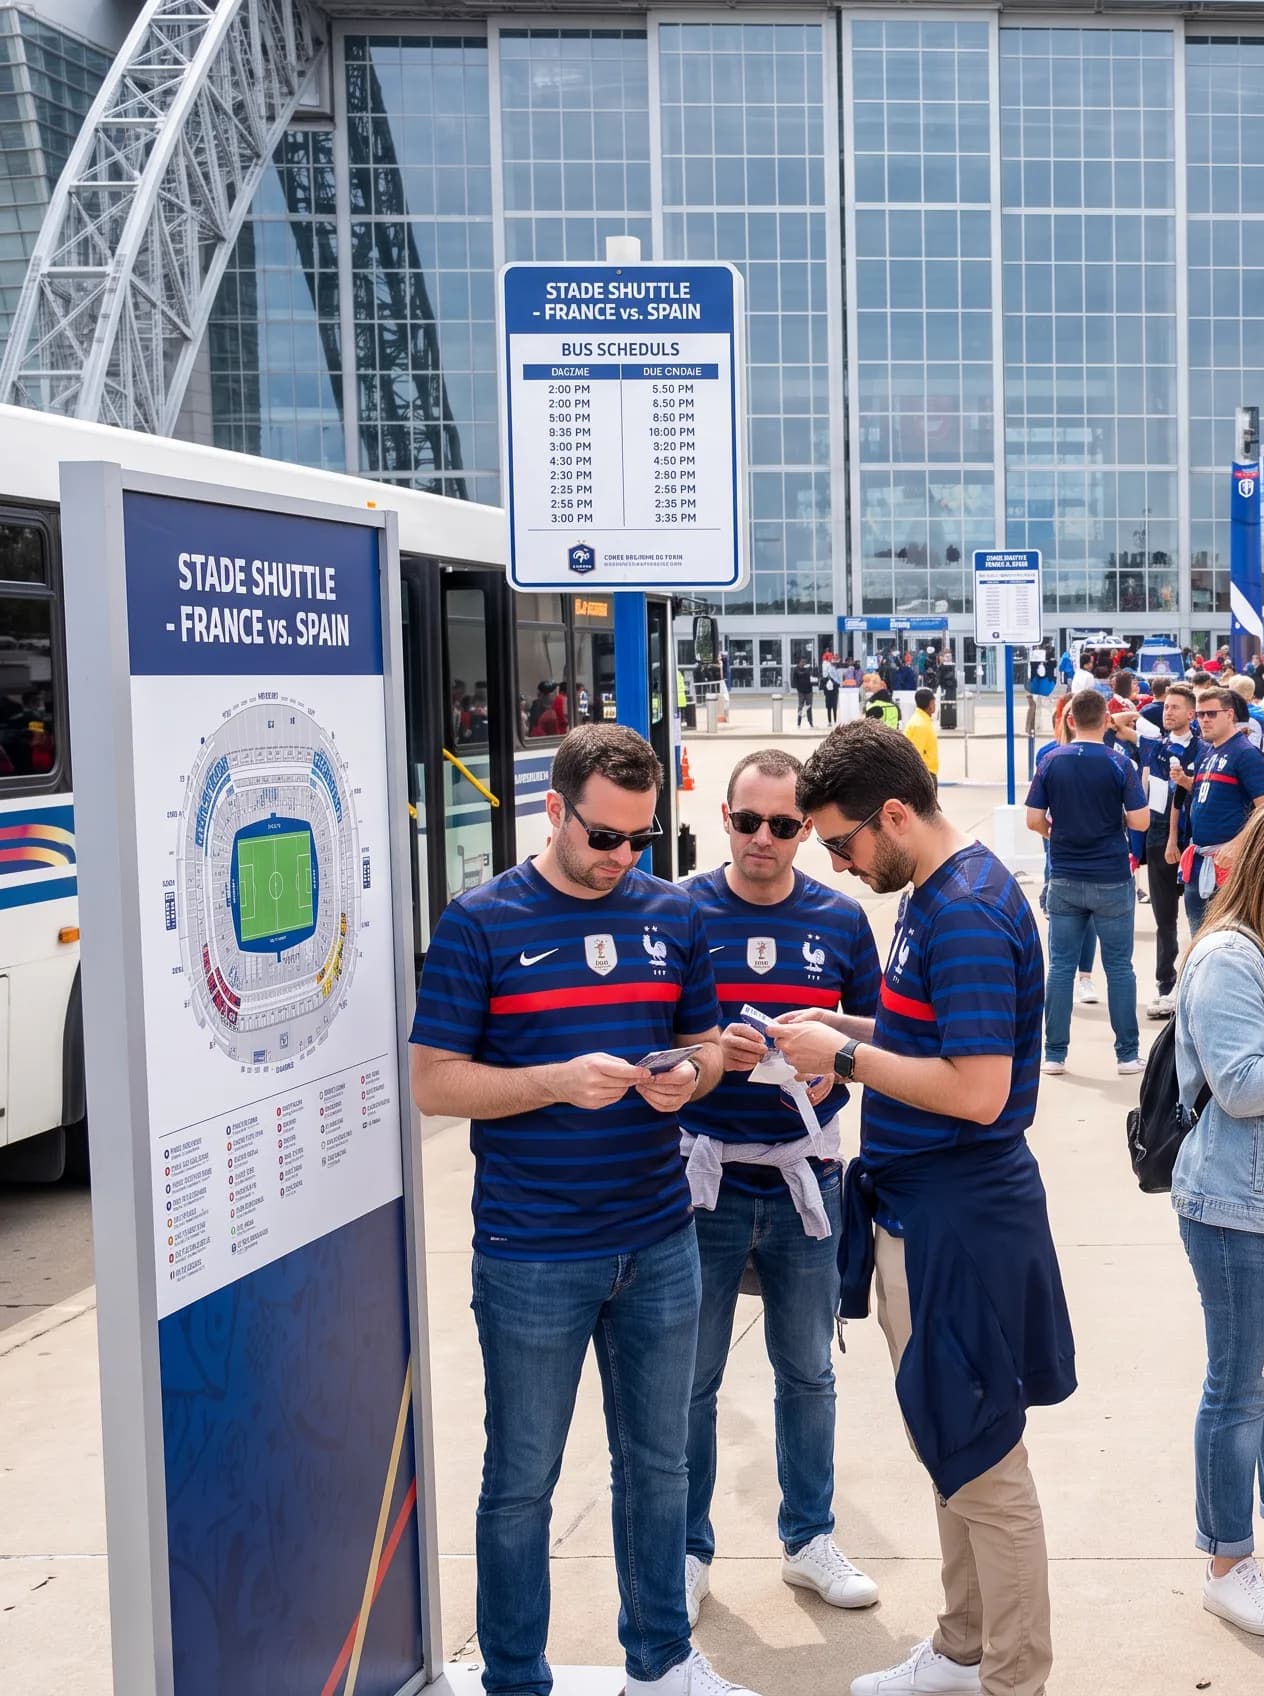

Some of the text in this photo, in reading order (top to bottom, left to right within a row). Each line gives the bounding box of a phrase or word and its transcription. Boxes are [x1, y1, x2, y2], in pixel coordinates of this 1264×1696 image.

[546, 282, 691, 299] STADE SHUTTLE
[545, 303, 616, 320] FRANCE
[620, 307, 644, 320] vs.
[647, 303, 701, 320] SPAIN
[562, 343, 680, 356] BUS SCHEDULS
[643, 367, 662, 376] DUE
[548, 385, 590, 394] 2:00 PM
[678, 384, 694, 393] PM
[548, 399, 590, 408] 2:00 PM
[678, 399, 694, 408] PM
[575, 413, 590, 422] PM
[679, 413, 695, 422] PM
[575, 427, 591, 437] PM
[679, 427, 695, 436] PM
[549, 442, 591, 451] 3:00 PM
[653, 442, 695, 451] 3:20 PM
[549, 456, 592, 466] 4:30 PM
[653, 456, 695, 465] 4:50 PM
[550, 471, 592, 480] 2:30 PM
[680, 470, 695, 480] PM
[576, 485, 592, 494] PM
[680, 485, 696, 494] PM
[576, 499, 593, 509] PM
[680, 499, 696, 508] PM
[551, 513, 593, 523] 3:00 PM
[681, 513, 696, 523] PM
[178, 552, 336, 601] STADE SHUTTLE
[180, 605, 264, 645] FRANCE
[267, 618, 292, 645] vs.
[296, 611, 350, 647] SPAIN
